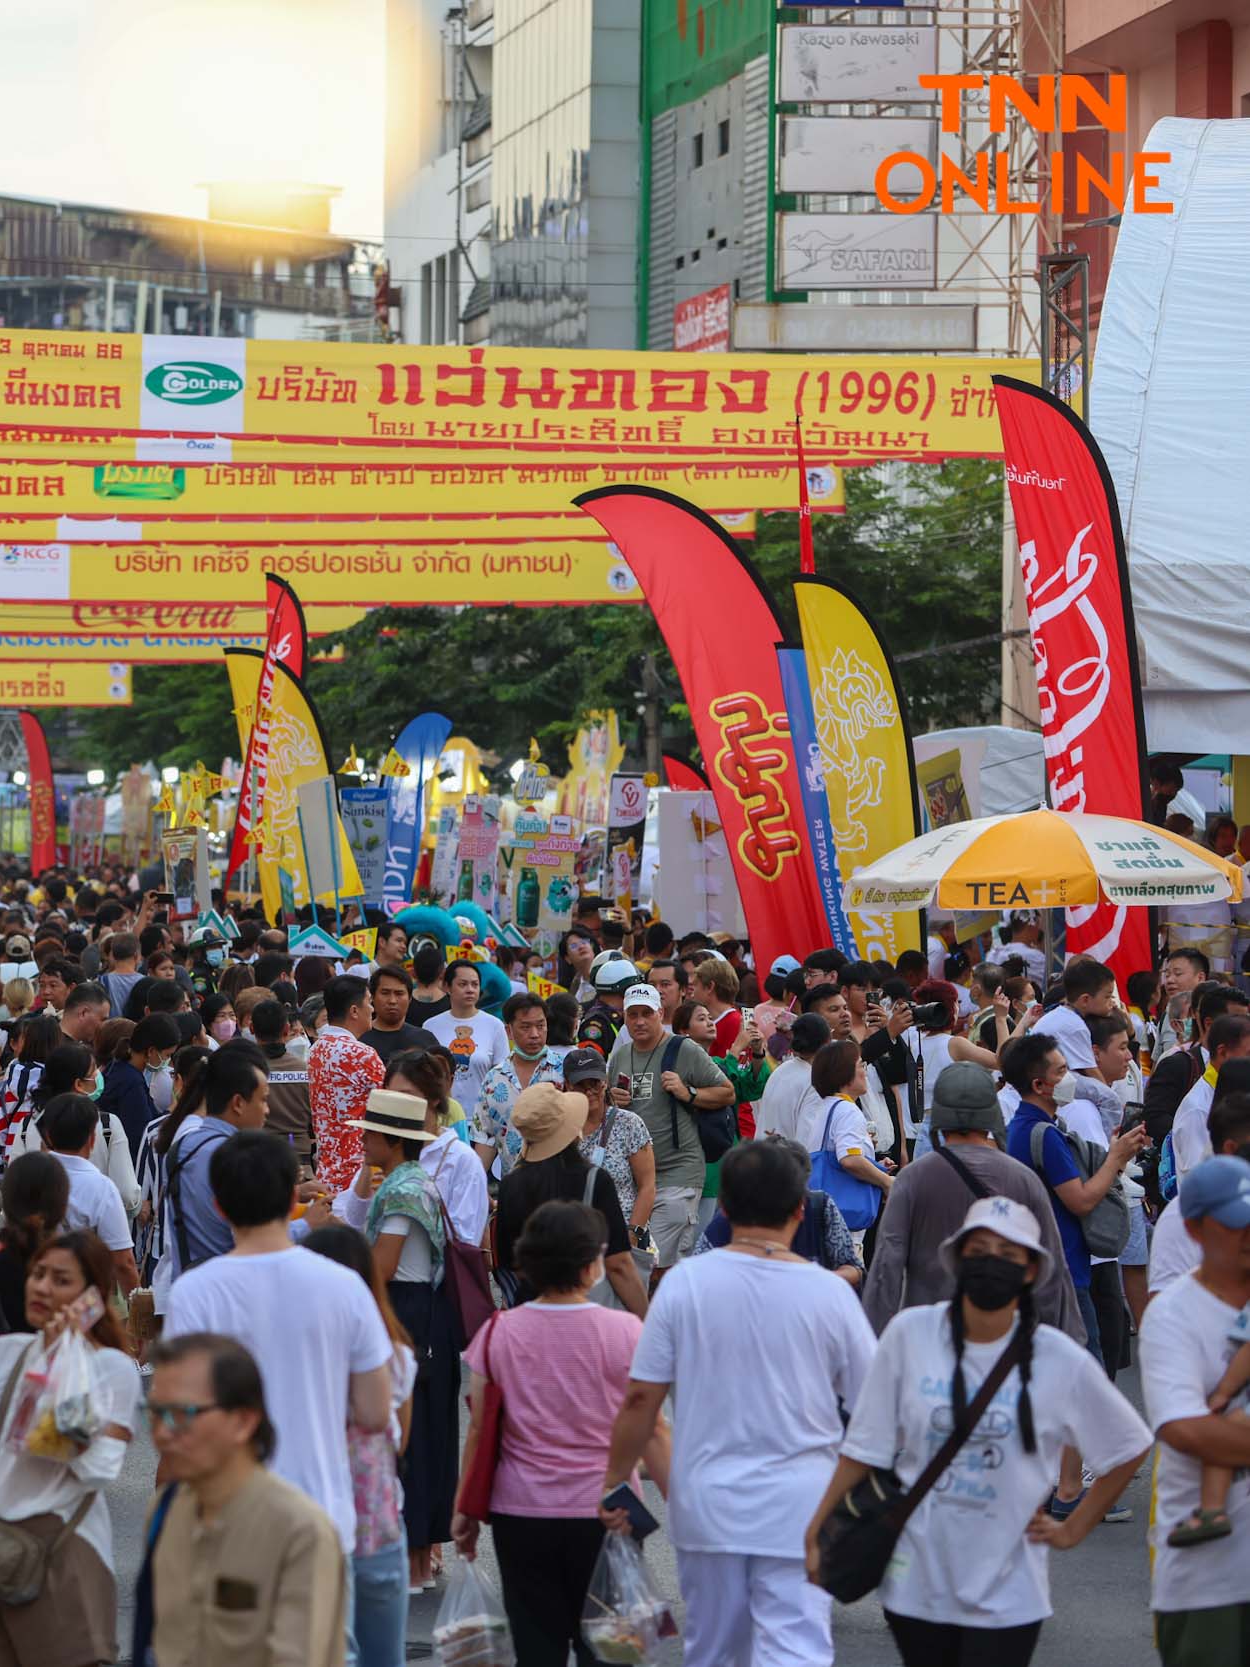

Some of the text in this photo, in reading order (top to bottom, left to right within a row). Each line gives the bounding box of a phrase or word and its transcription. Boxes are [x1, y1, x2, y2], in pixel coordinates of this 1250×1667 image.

[799, 31, 919, 50] Kazuo Kawasaki
[830, 249, 928, 272] SAFARI
[22, 341, 86, 360] ตุลาคม
[4, 367, 122, 409] มีมงคล
[162, 371, 240, 394] GOLDEN
[256, 365, 358, 403] บริษัท
[375, 348, 771, 413] แว่นทอง
[794, 370, 937, 421] (1996)
[368, 412, 413, 436] โดย
[23, 547, 60, 560] KCG
[115, 550, 182, 573] บริษัท
[261, 546, 402, 574] คอร์ปอเรชั่น
[414, 551, 471, 573] จำกัด
[481, 553, 572, 577] (มหาชน)
[343, 804, 385, 819] Sunkist
[1094, 836, 1162, 852] ชาแท้
[1113, 852, 1185, 869] สดชื่น
[1109, 881, 1215, 899] ทางเลือกสุขภาพ
[283, 1073, 310, 1081] POLICE
